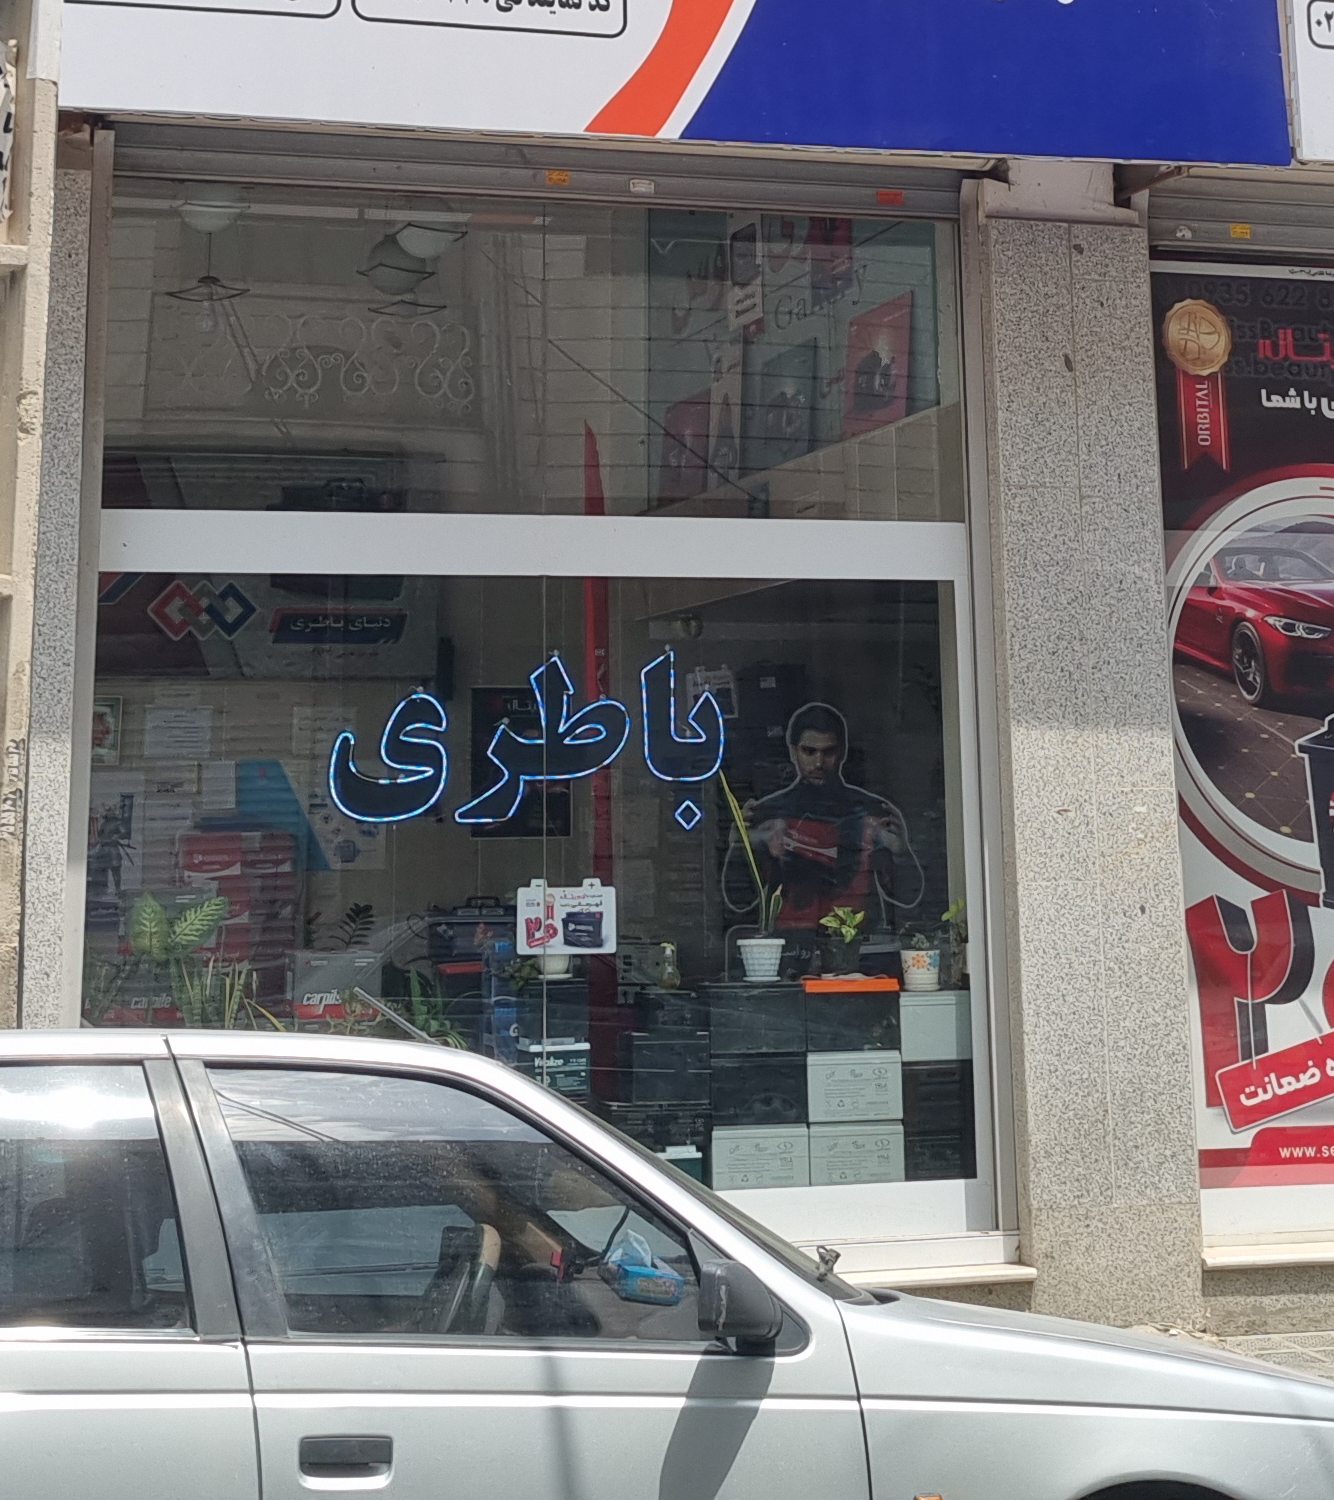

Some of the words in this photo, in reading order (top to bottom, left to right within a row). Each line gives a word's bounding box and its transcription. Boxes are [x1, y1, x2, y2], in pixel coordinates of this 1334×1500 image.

[1194, 379, 1212, 447] ORBITAL
[1261, 386, 1301, 410] شما
[1303, 390, 1317, 416] با
[329, 645, 725, 831] باطری
[1238, 1063, 1321, 1107] ضمانت
